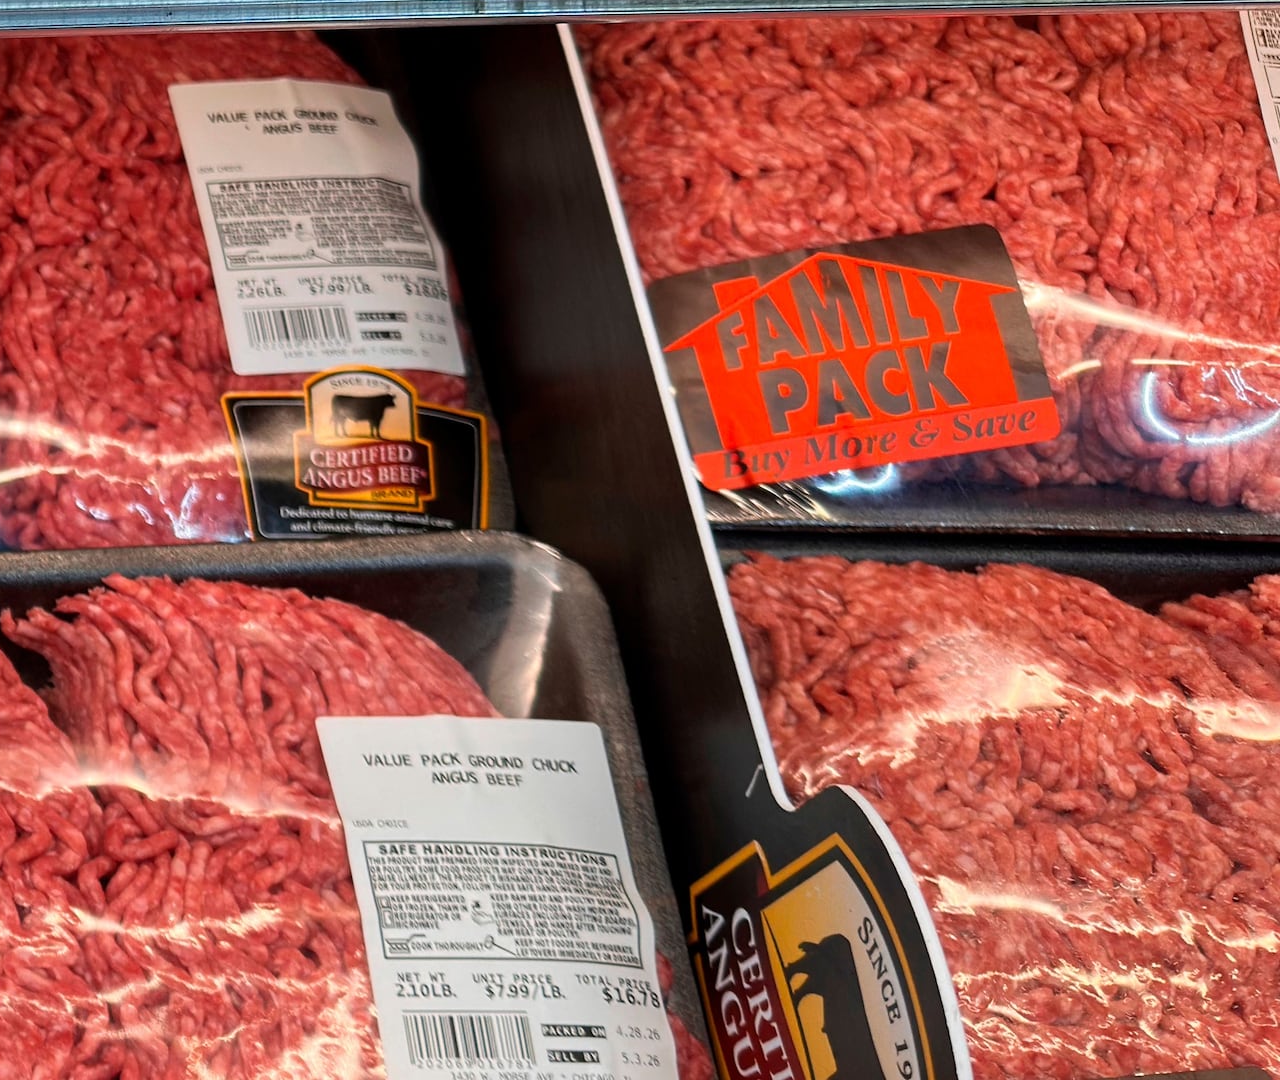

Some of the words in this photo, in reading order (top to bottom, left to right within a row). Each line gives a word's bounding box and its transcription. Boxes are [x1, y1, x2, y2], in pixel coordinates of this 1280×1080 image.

[208, 112, 248, 123] VALUE
[254, 111, 287, 121] PACK
[294, 109, 338, 120] GROUND
[262, 123, 303, 135] ANGUS
[308, 124, 338, 134] BEEF
[715, 258, 962, 372] FAMILY
[755, 340, 971, 435] PACK
[722, 441, 792, 480] Buy
[804, 425, 899, 464] More
[909, 419, 941, 449] &
[950, 405, 1038, 441] Save
[310, 446, 414, 468] CERTIFIED
[303, 468, 374, 488] ANGUS
[378, 467, 421, 484] BEEF
[362, 754, 412, 767] VALUE
[421, 753, 460, 766] PACK
[468, 756, 523, 769] GROUND
[532, 758, 578, 774] CHUCK
[432, 771, 478, 784] ANGUS
[487, 773, 523, 786] BEEF
[857, 916, 902, 1024] SINCE
[396, 984, 457, 998] 2.10LB.
[485, 984, 566, 1001] $7.99/LB.
[602, 987, 661, 1009] $16.78
[702, 904, 762, 1080] ANGU
